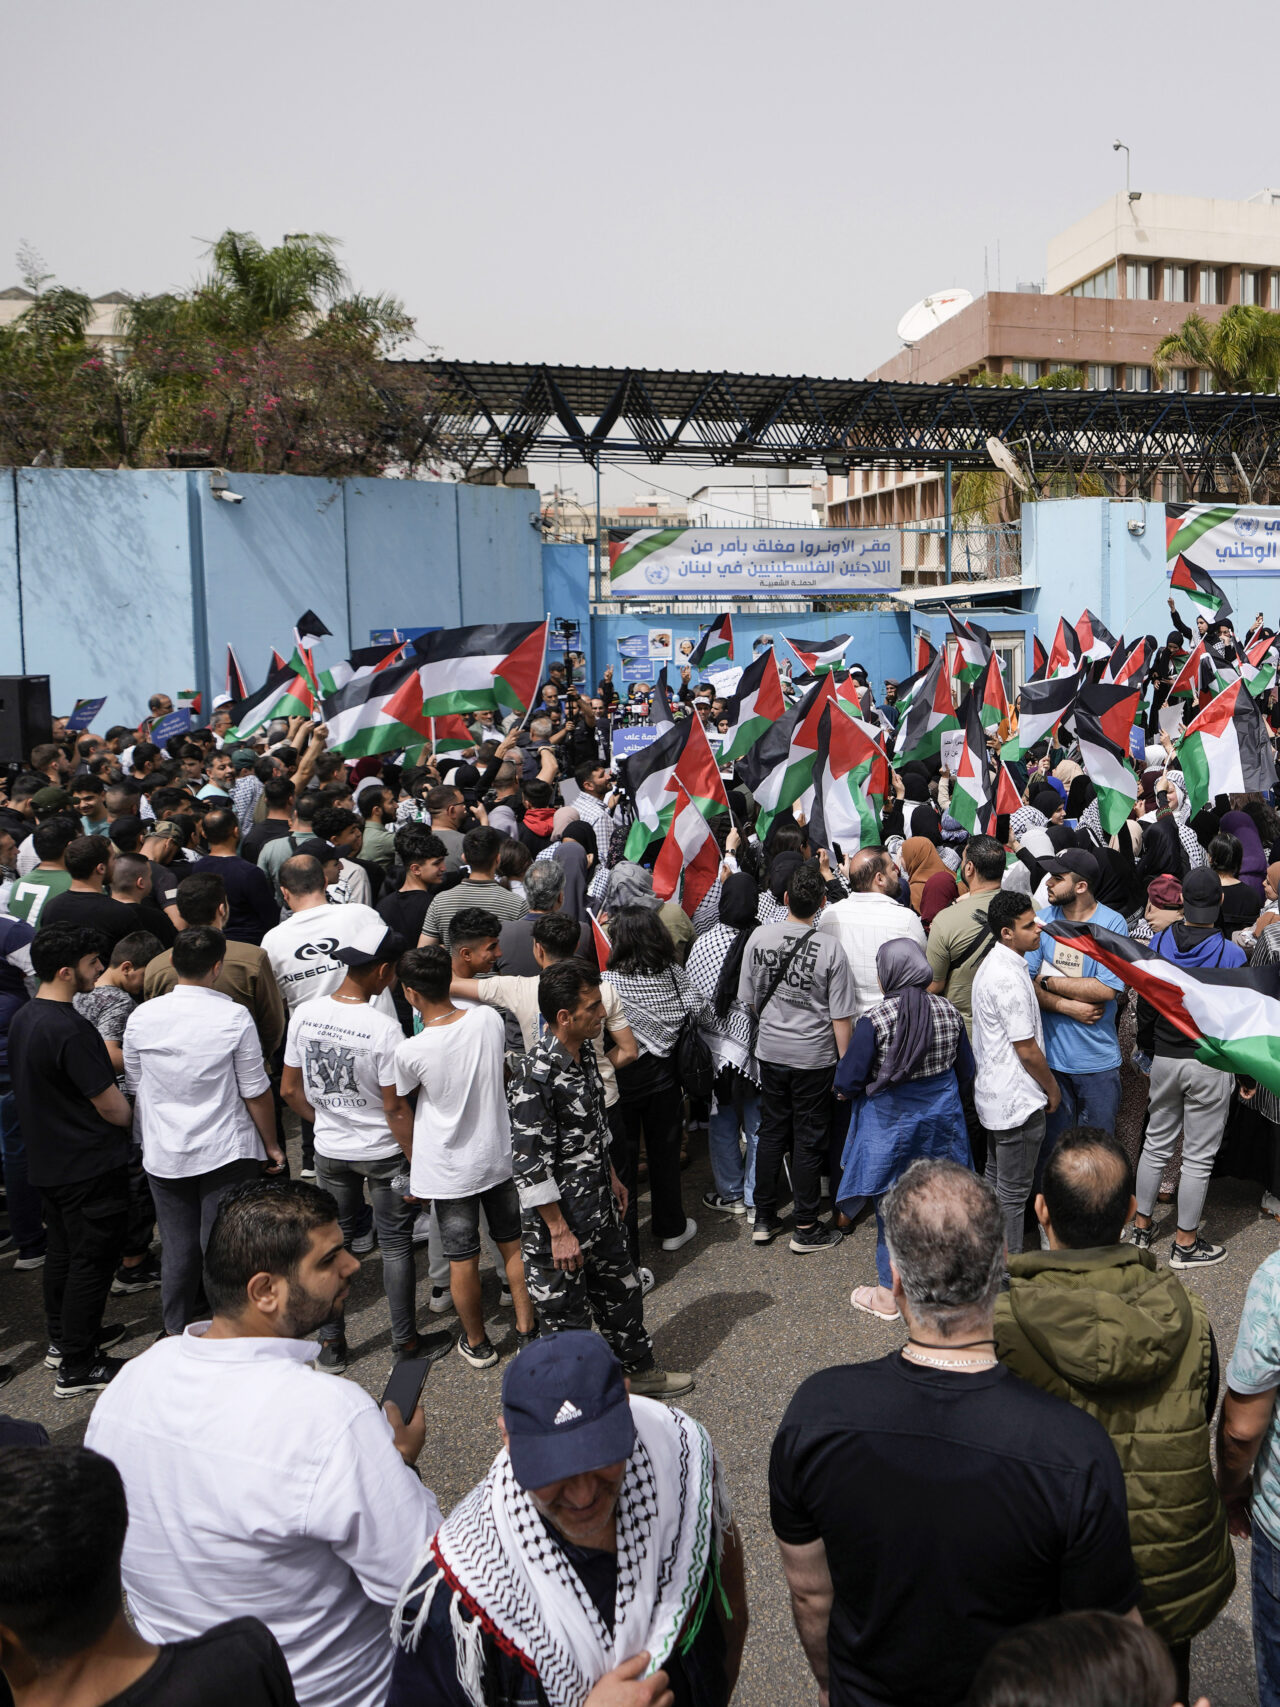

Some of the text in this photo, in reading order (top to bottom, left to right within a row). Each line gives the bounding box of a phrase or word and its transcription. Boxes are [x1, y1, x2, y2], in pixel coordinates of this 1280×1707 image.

[691, 539, 713, 555] من
[717, 536, 747, 557] بأمر
[752, 539, 795, 553] مغلق
[1216, 541, 1277, 563] الوطني
[678, 560, 891, 578] اللاجئين الفلسطينيين في لبنان
